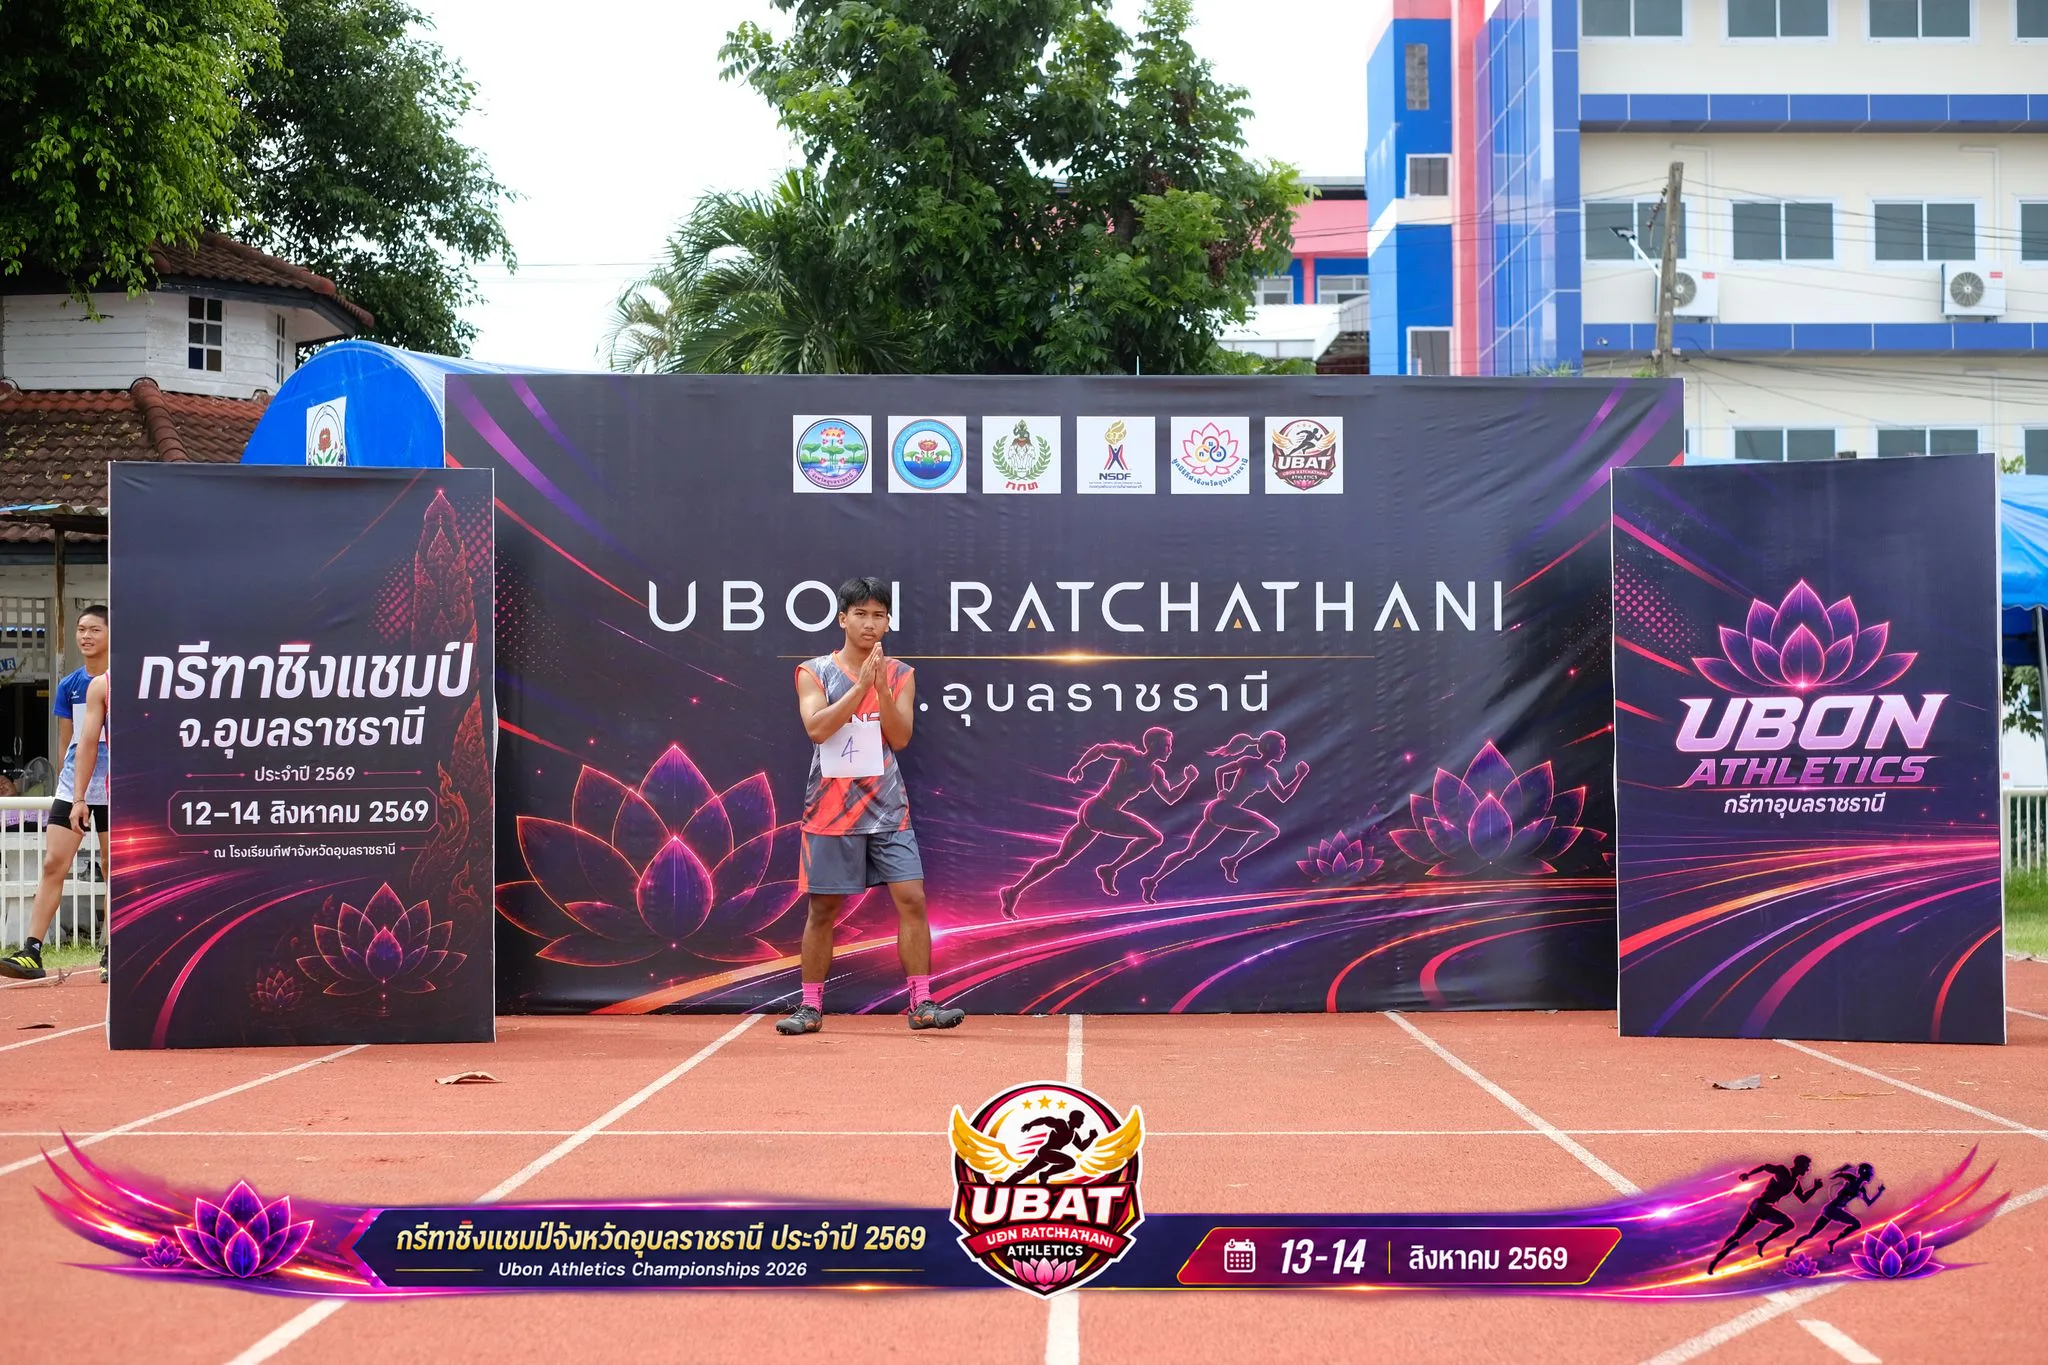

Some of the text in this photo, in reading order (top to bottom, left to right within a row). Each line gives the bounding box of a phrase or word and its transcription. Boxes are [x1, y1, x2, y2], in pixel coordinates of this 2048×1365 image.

[1278, 456, 1331, 469] UBAT
[1005, 481, 1039, 491] กกท
[950, 581, 1502, 632] RATCHATHANI
[138, 641, 474, 700] กรีฑาชิงแชมป์
[918, 670, 1269, 728] .อุบลราชธานี
[179, 705, 426, 759] จ.อุบลราชธานี
[1675, 693, 1949, 752] UBON
[841, 736, 860, 763] 4
[254, 765, 356, 782] ประจำปี 2569
[1676, 755, 1936, 788] ATHLETICS
[270, 801, 360, 825] สิงหาคม
[369, 800, 429, 823] 2569
[1724, 792, 1887, 819] กรีฑาอุบลราชธานี
[214, 848, 226, 858] ณ
